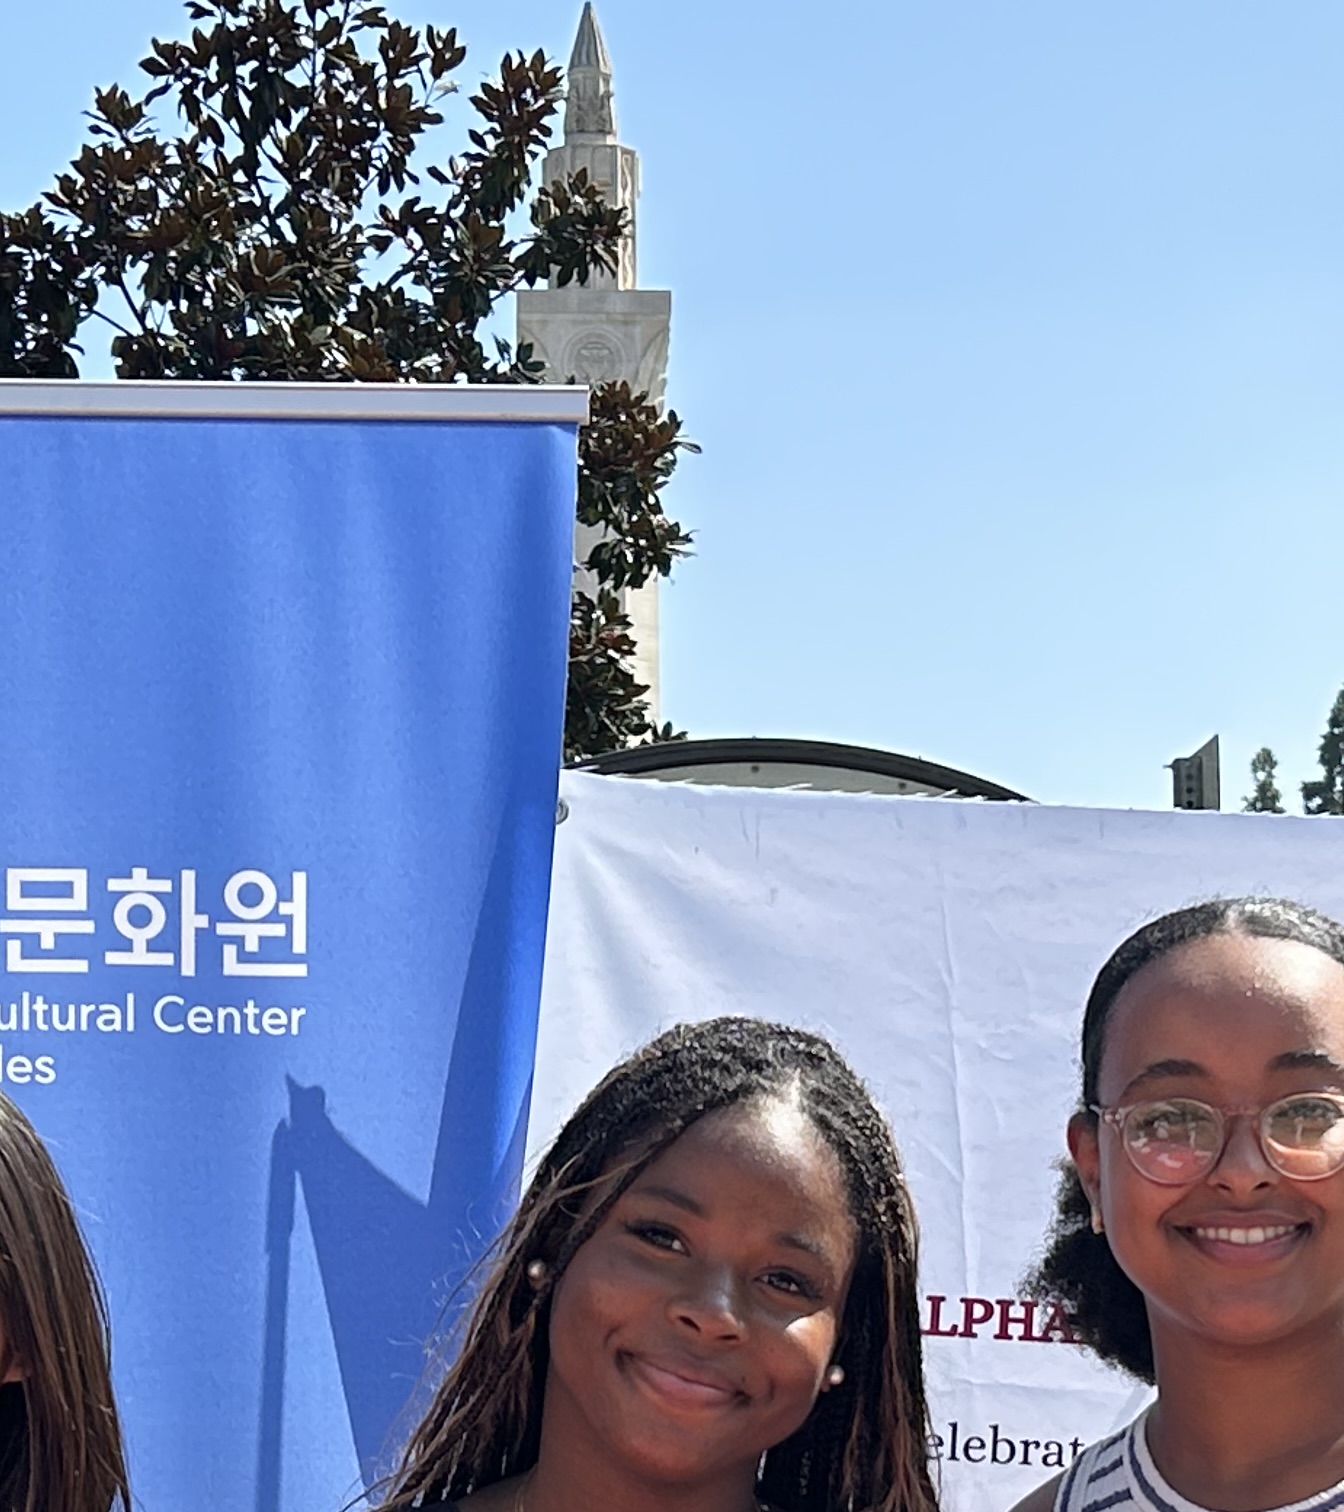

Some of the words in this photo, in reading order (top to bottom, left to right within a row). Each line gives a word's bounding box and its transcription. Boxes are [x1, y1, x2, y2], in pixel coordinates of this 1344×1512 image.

[153, 995, 307, 1036] Center
[920, 1295, 1088, 1344] LPHA
[925, 1422, 1084, 1468] elebrat
